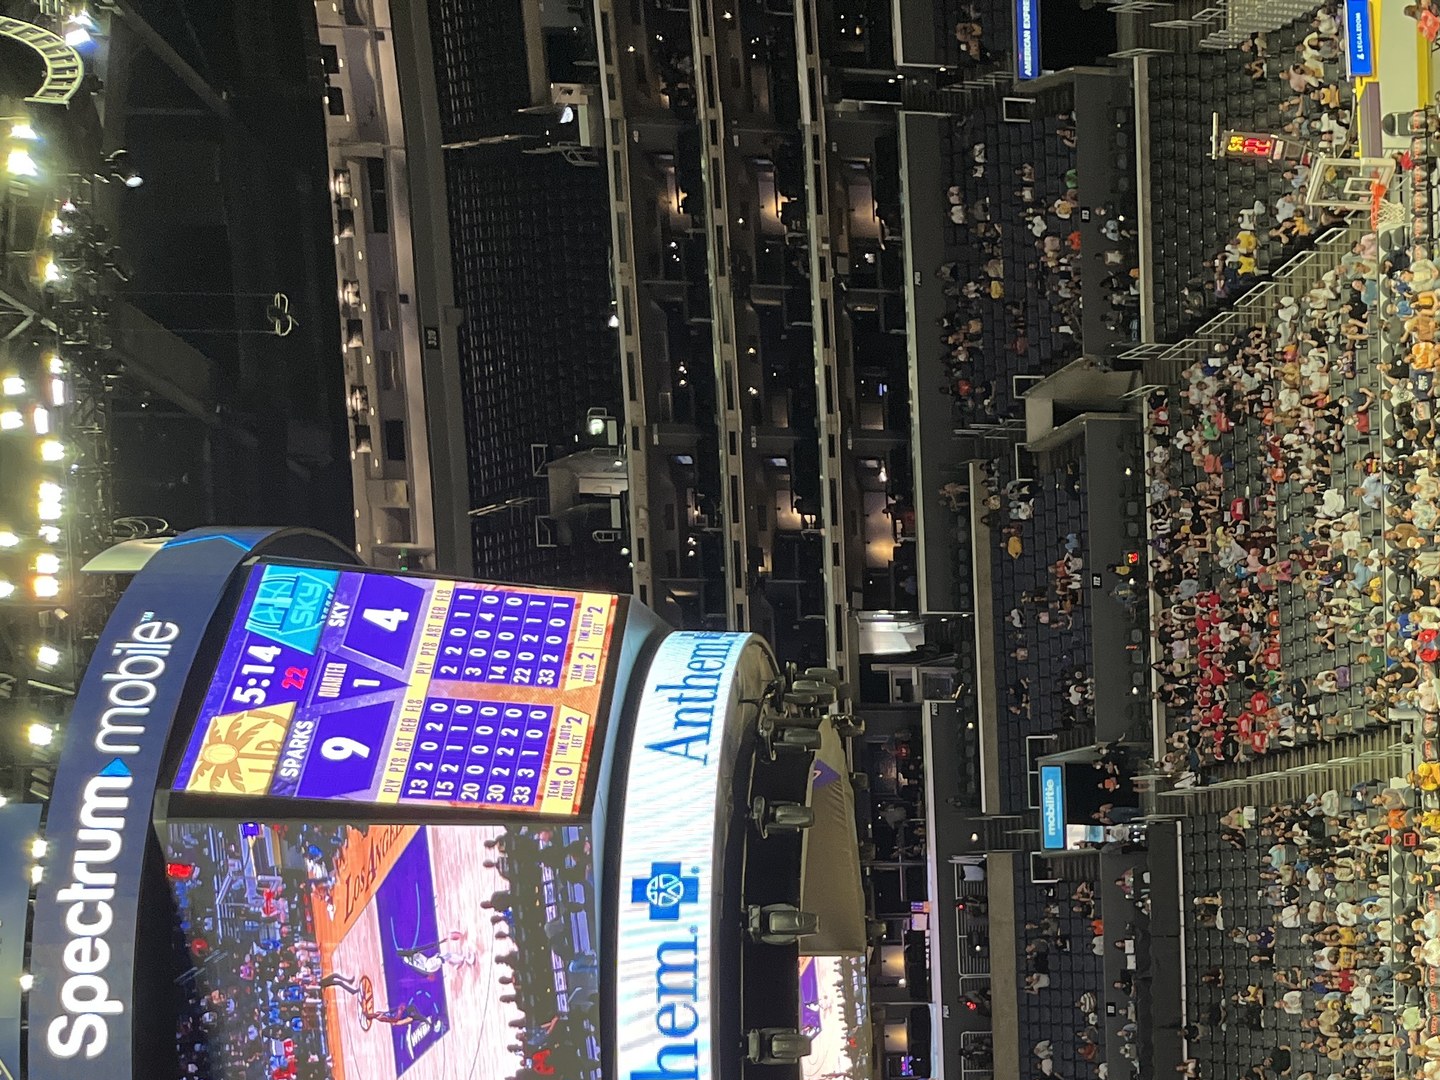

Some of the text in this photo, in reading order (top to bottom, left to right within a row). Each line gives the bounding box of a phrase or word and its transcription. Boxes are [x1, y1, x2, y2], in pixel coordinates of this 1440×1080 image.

[1024, 31, 1032, 76] AMERICAN
[506, 597, 523, 606] 0
[328, 602, 350, 627] SKY
[587, 606, 603, 614] 2
[362, 608, 409, 632] 4
[549, 618, 566, 627] 0
[415, 590, 451, 674] PLY PTS AST REB FLS
[450, 628, 467, 637] 0
[465, 595, 499, 676] 3 0 0 4 0
[498, 632, 515, 640] 0
[522, 634, 539, 642] 2
[546, 636, 562, 644] 0
[445, 646, 462, 655] 2
[493, 650, 511, 659] 0
[518, 652, 535, 661] 0
[578, 652, 594, 660] 2
[542, 654, 559, 663] 2
[232, 646, 281, 704] 5:14
[440, 666, 458, 674] 2
[488, 666, 507, 680] 14
[513, 668, 531, 683] 22
[537, 669, 555, 685] 33
[570, 664, 584, 680] TEAM
[282, 666, 308, 690] 22
[317, 663, 347, 697] QUARTER
[353, 678, 380, 687] 1
[455, 705, 473, 714] 0
[644, 642, 734, 766] Anthem
[529, 710, 547, 720] 0
[566, 716, 582, 725] 2
[526, 729, 543, 738] 0
[555, 724, 572, 756] TIME OUTS
[572, 734, 583, 748] LEFT
[280, 720, 314, 777] SPARKS
[321, 737, 370, 760] 9
[383, 700, 422, 792] PLY PTS AST REB FLS
[408, 703, 448, 795] 13 2 0 2 0
[460, 707, 498, 800] 20 0 0 0 0
[486, 708, 522, 802] 30 2 2 2 0
[440, 764, 459, 773] 2
[517, 768, 535, 778] 3
[556, 767, 572, 776] 0
[434, 781, 454, 796] 15
[512, 786, 531, 804] 33
[547, 780, 560, 798] TEAM
[560, 780, 575, 800] FOULS
[1046, 779, 1056, 836] mobilitie
[47, 621, 180, 1057] Spectrum mobile
